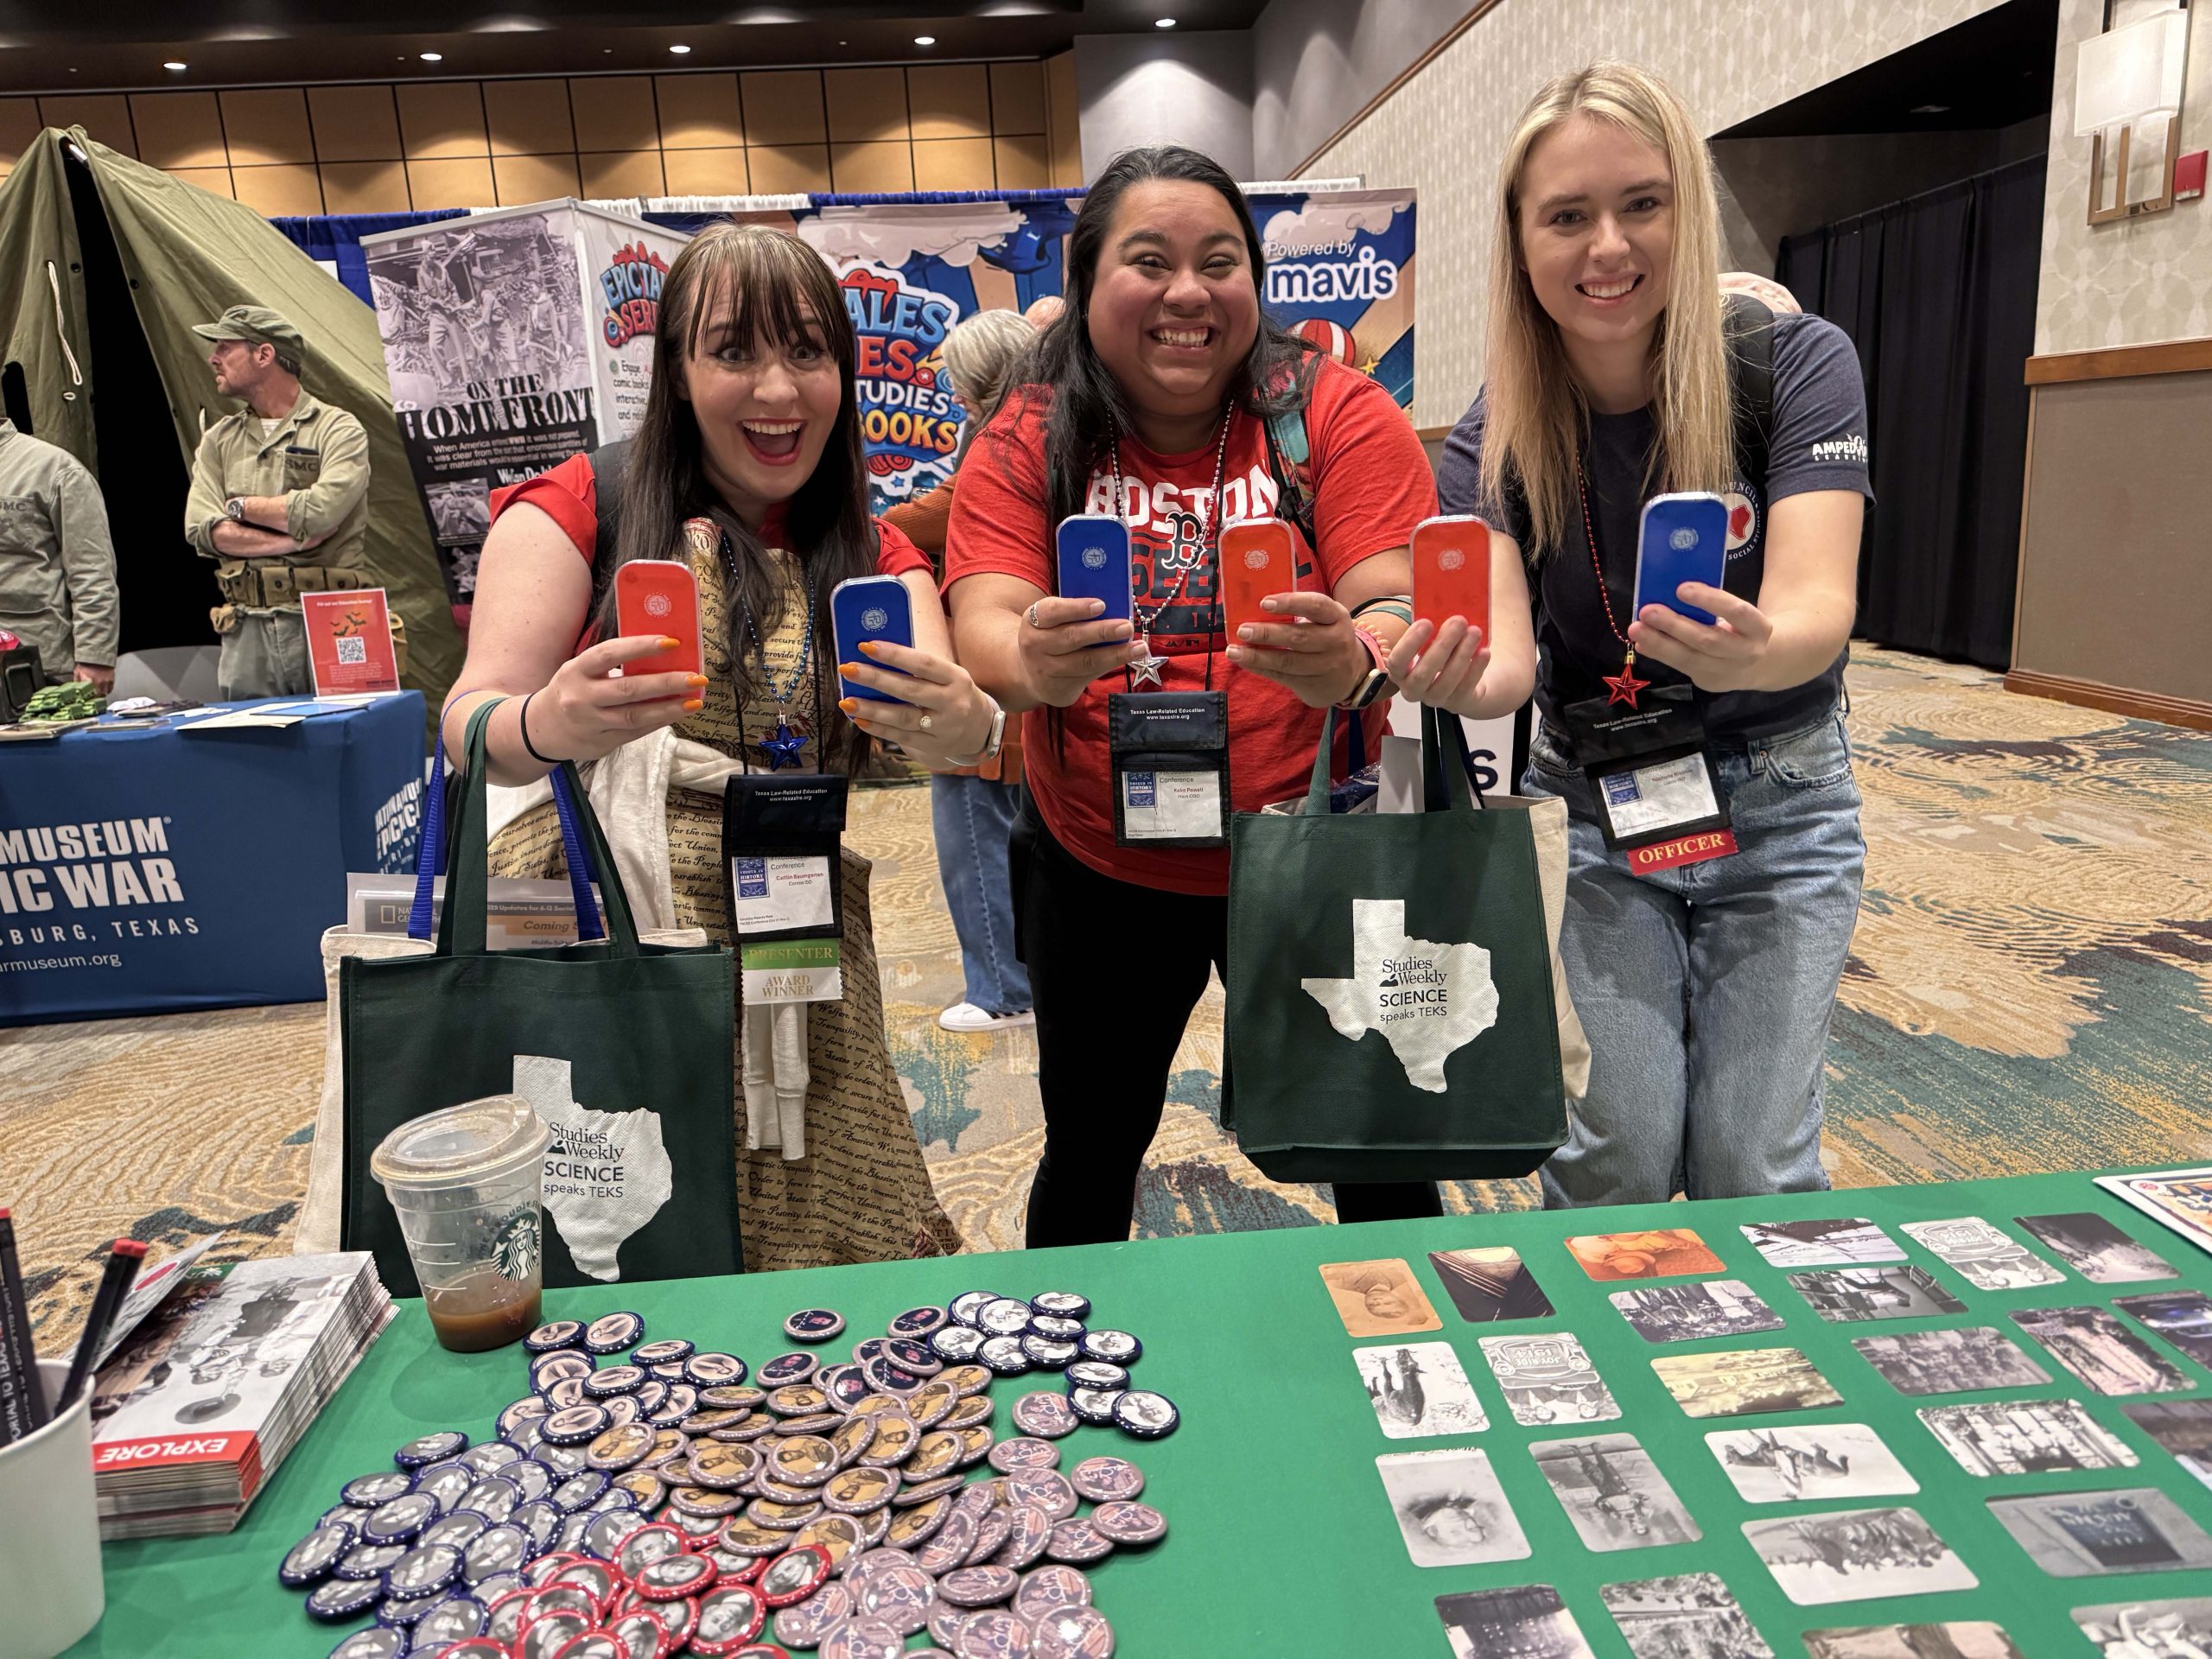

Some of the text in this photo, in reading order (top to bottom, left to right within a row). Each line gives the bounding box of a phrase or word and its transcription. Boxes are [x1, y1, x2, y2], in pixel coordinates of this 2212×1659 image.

[1267, 240, 1356, 257] Powered by
[601, 262, 642, 308] EPIC
[1269, 249, 1395, 301] mavis
[843, 286, 951, 346] ALES
[467, 373, 544, 400] ON THE
[856, 379, 950, 415] TUDIES
[396, 387, 596, 441] HOME FRONT
[864, 409, 958, 454] OOKS
[433, 444, 457, 454] When
[460, 439, 490, 451] America
[452, 450, 473, 461] clear
[474, 448, 493, 459] from
[1813, 441, 1856, 456] AMPED
[449, 460, 487, 470] materials
[1085, 465, 1280, 534] BOSTON
[1722, 481, 1758, 503] OUNCIL
[1728, 544, 1755, 561] SOCIAL
[1638, 832, 1726, 864] OFFICER
[54, 858, 185, 908] WAR
[111, 917, 199, 938] TEXAS
[523, 920, 570, 933] Coming
[748, 946, 833, 962] PRESENTER
[1382, 956, 1433, 974] Studies
[766, 975, 810, 988] AWARD
[1398, 970, 1447, 986] Weekly
[762, 986, 814, 998] WINNER
[1379, 988, 1447, 1007] SCIENCE
[1380, 1006, 1447, 1024] speaks TEKS
[549, 1122, 607, 1145] Studies
[566, 1140, 625, 1162] Weekly
[544, 1160, 625, 1182] SCIENCE
[748, 1171, 774, 1184] Order
[543, 1183, 624, 1198] speaks TEKS
[97, 1436, 229, 1465] EXPLORE
